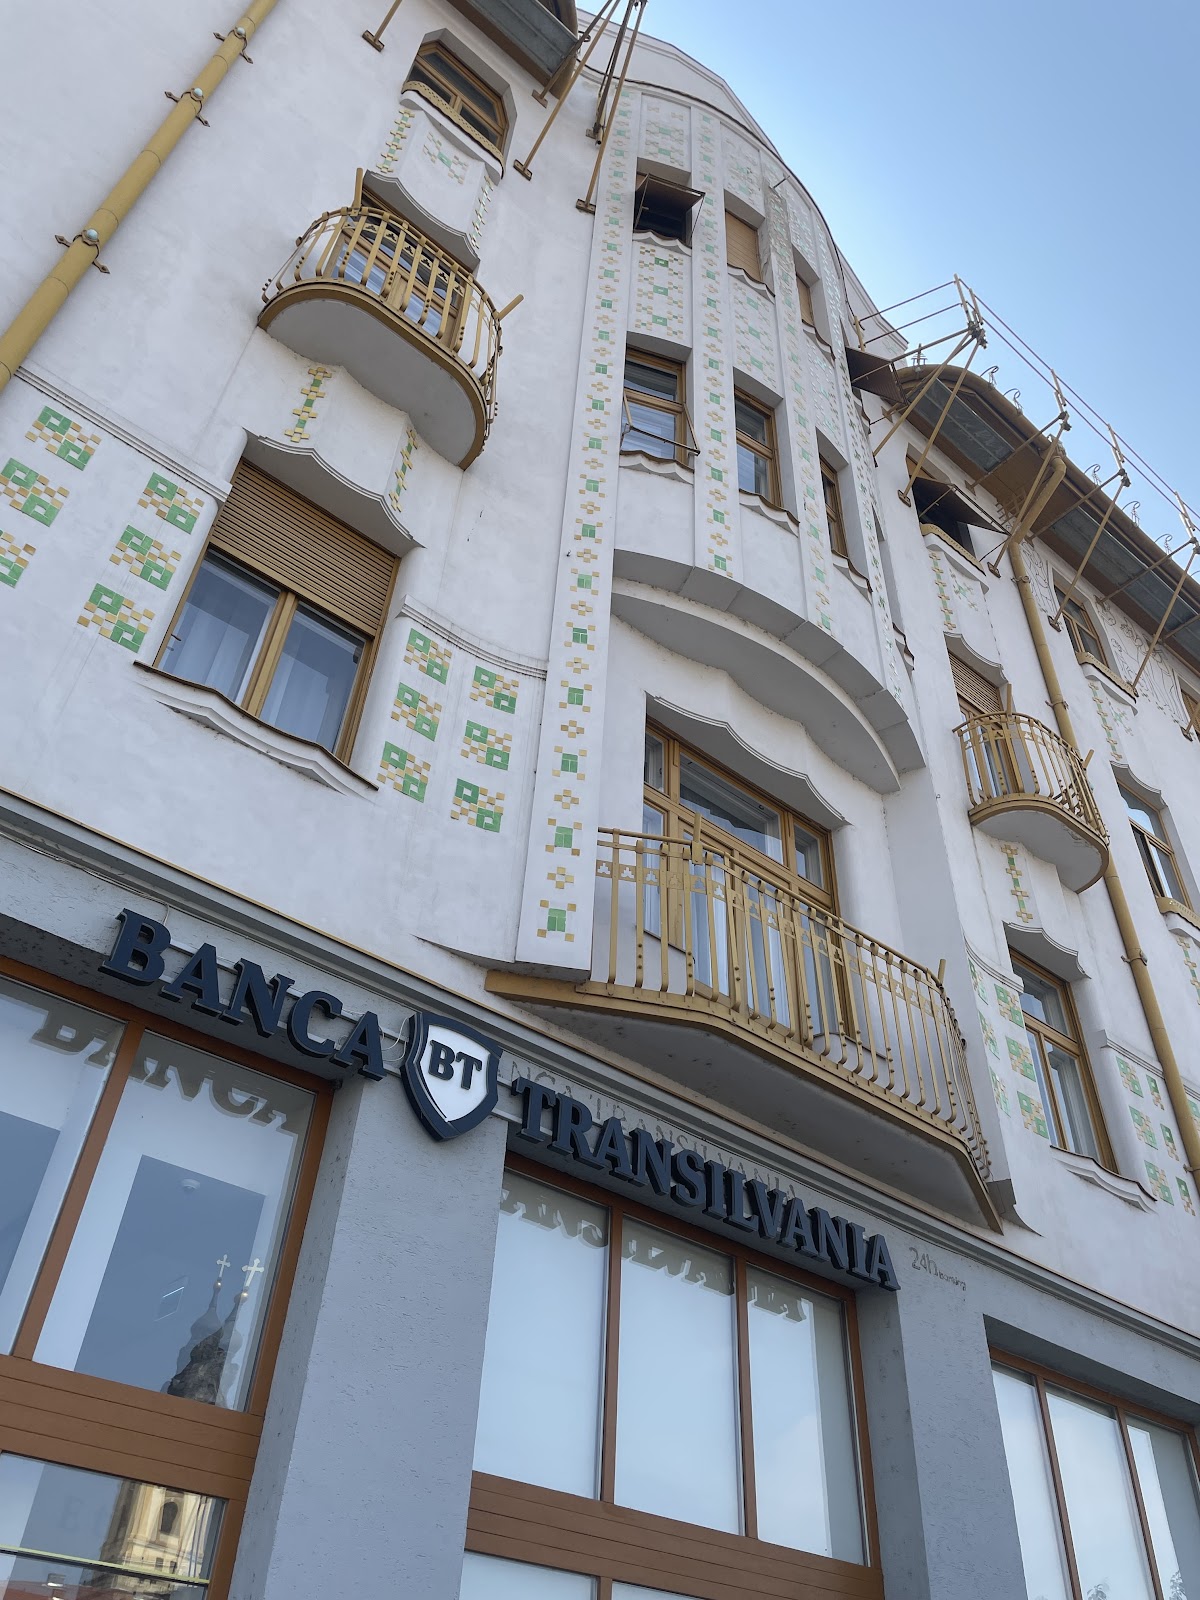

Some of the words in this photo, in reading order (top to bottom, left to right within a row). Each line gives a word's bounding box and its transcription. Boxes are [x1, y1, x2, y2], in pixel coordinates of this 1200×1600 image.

[98, 908, 388, 1081] BANCA
[428, 1040, 482, 1090] BT
[511, 1077, 901, 1292] TRANSILVANIA
